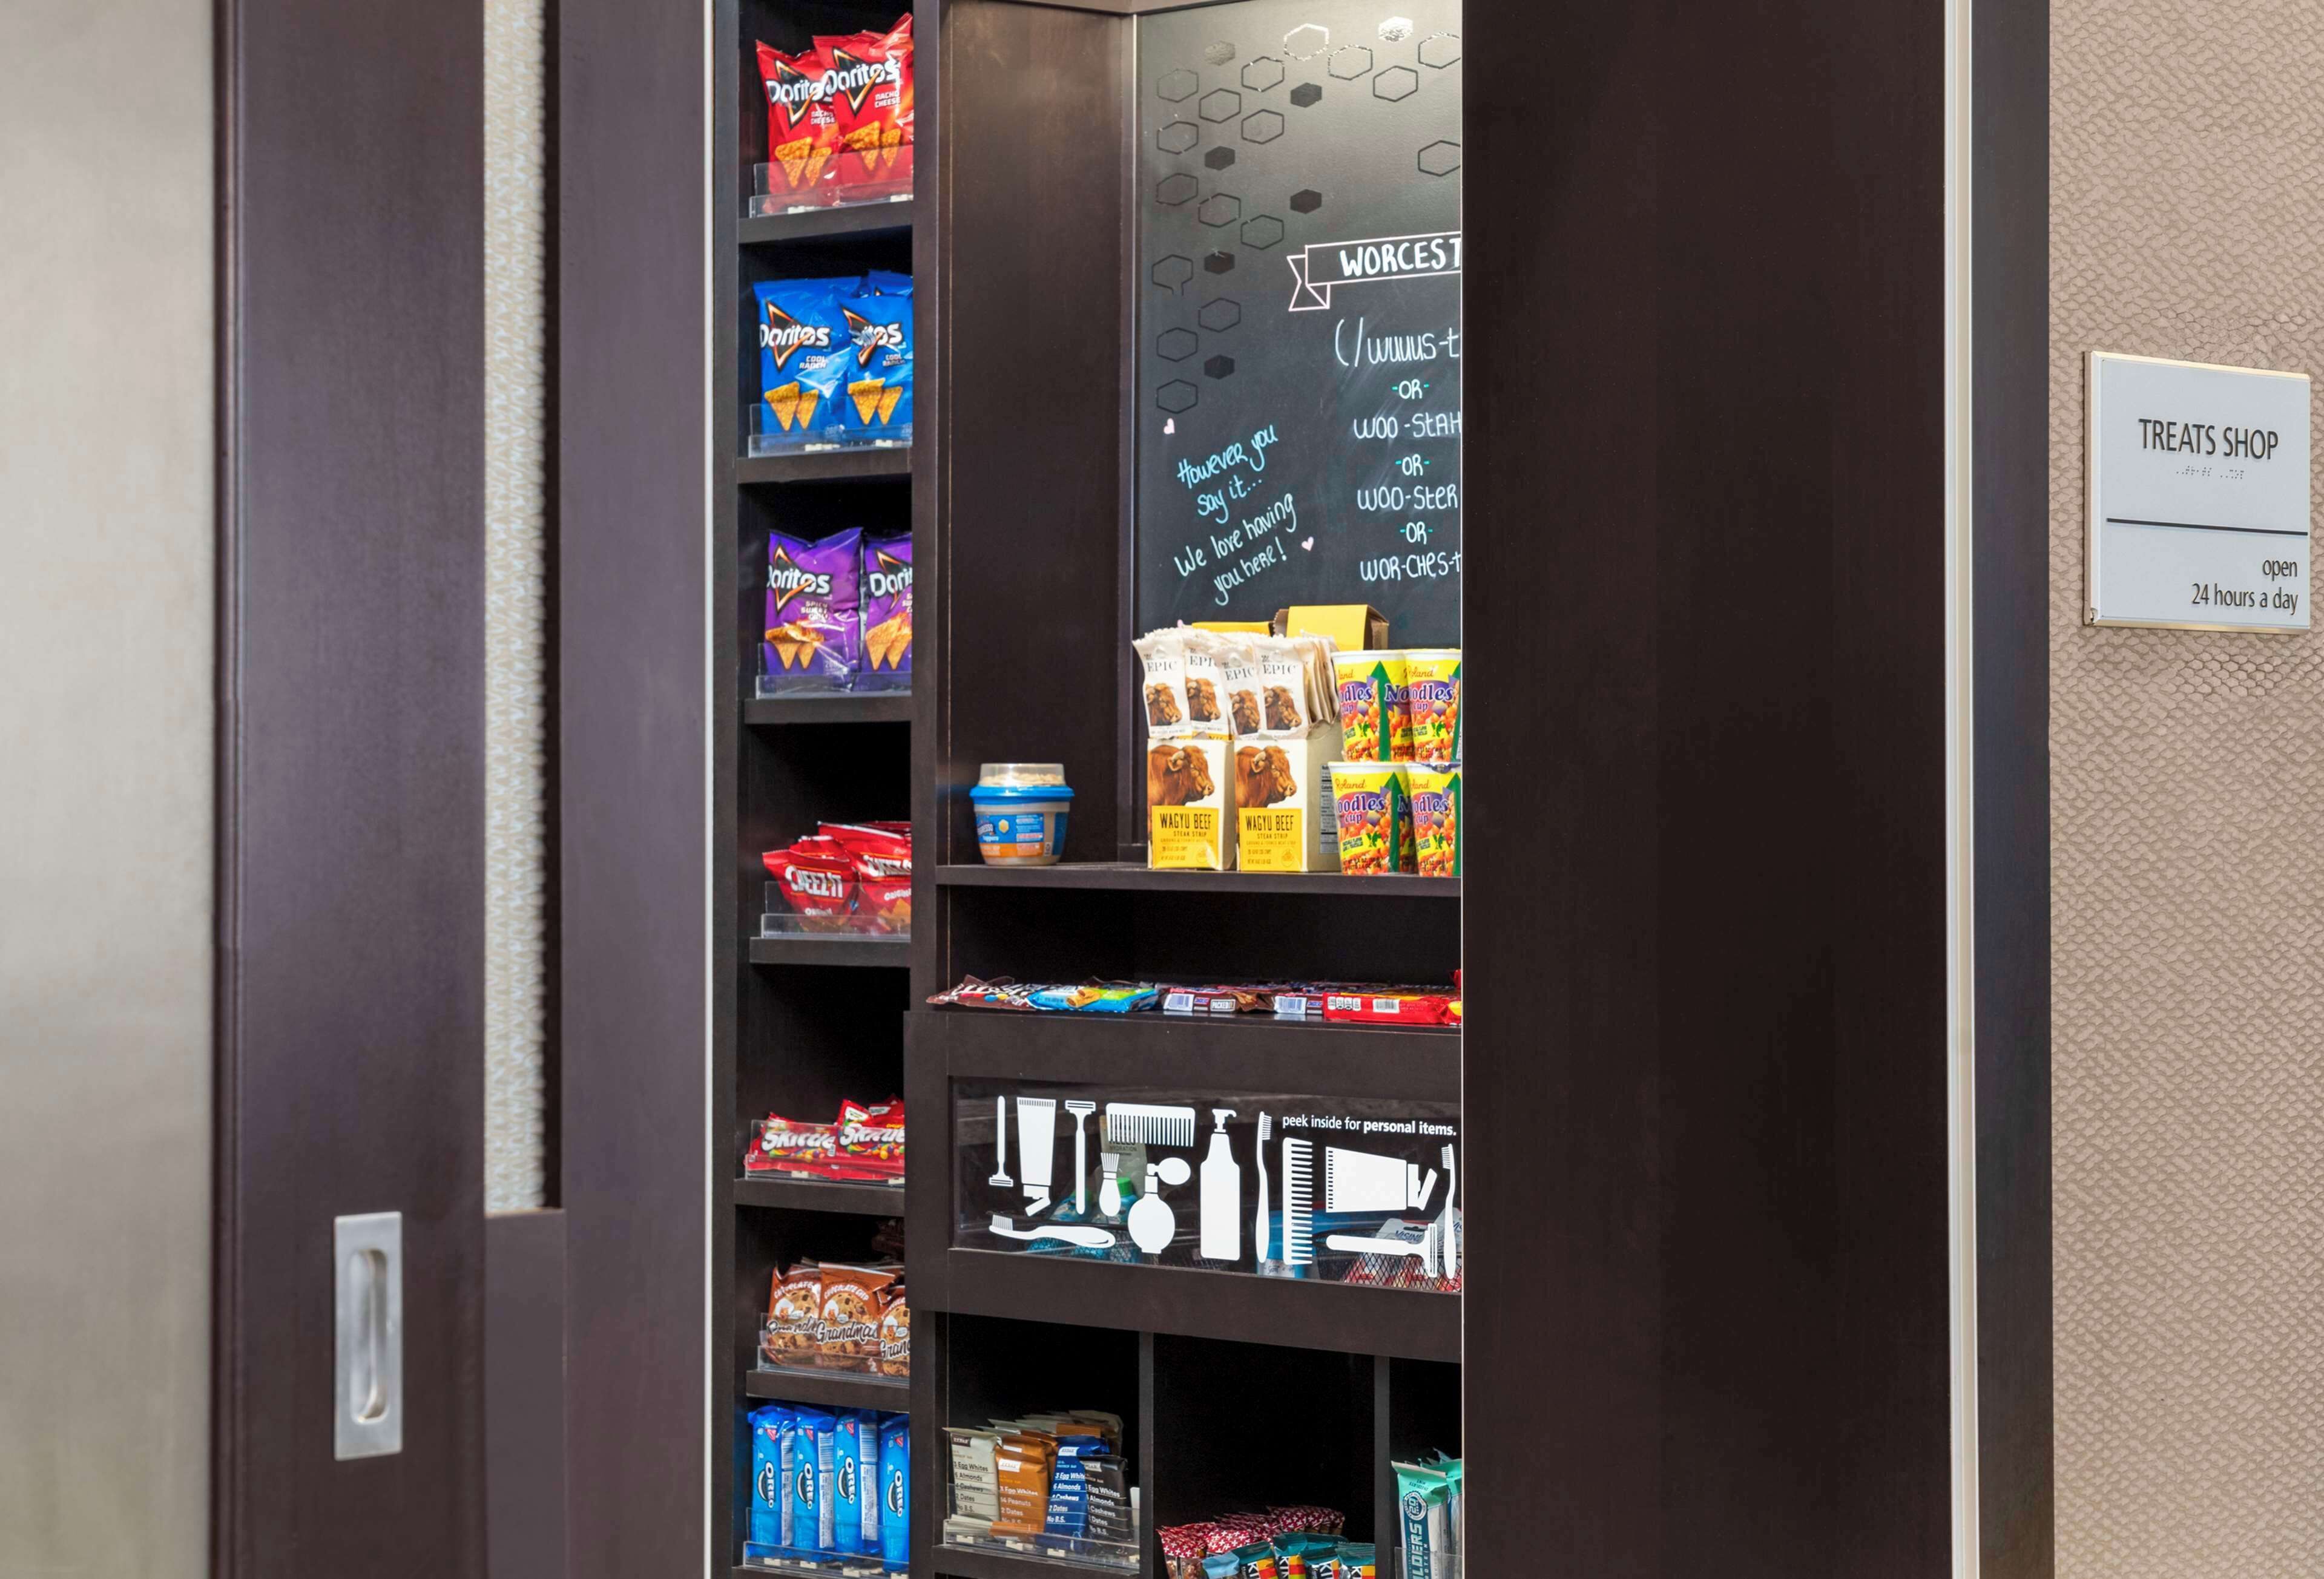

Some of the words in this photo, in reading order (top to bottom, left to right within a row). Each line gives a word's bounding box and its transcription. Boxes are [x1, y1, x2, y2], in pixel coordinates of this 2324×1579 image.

[760, 323, 831, 348] Doritos
[2138, 418, 2216, 455] TREATS
[2223, 427, 2279, 459] SHOP
[1249, 425, 1278, 471] you
[1197, 489, 1229, 524] say
[1174, 545, 1206, 576] We
[1210, 530, 1243, 559] love
[1242, 493, 1297, 533] having
[2262, 560, 2297, 581] open
[1214, 568, 1244, 606] you
[2191, 583, 2210, 605] 24
[2214, 583, 2255, 608] hours
[2260, 591, 2268, 608] a
[2273, 586, 2299, 616] day
[1147, 661, 1177, 672] EPIC
[1190, 655, 1217, 667] EPI
[1225, 667, 1254, 680] EPIC
[1263, 664, 1298, 674] EPIC
[1409, 683, 1453, 702] oodles
[1337, 793, 1385, 813] oodles
[1160, 813, 1190, 829] WAGYU
[1194, 813, 1211, 830] BEEF
[1245, 815, 1272, 831] WAGYU
[1276, 815, 1294, 831] BEEF
[1345, 812, 1362, 824] cup
[1283, 1114, 1308, 1129] peek
[1311, 1115, 1341, 1129] inside
[1345, 1117, 1361, 1131] for
[1363, 1121, 1415, 1134] personal
[1419, 1121, 1457, 1136] items.
[969, 1463, 988, 1472] Whites
[960, 1472, 983, 1482] Almonds
[1016, 1488, 1038, 1496] Whites
[1088, 1484, 1099, 1494] Egg
[1099, 1486, 1120, 1497] Whites
[1090, 1495, 1115, 1506] Almonds
[1006, 1508, 1023, 1516] Dates
[1090, 1505, 1116, 1517] Cashews
[1091, 1516, 1108, 1526] Dates
